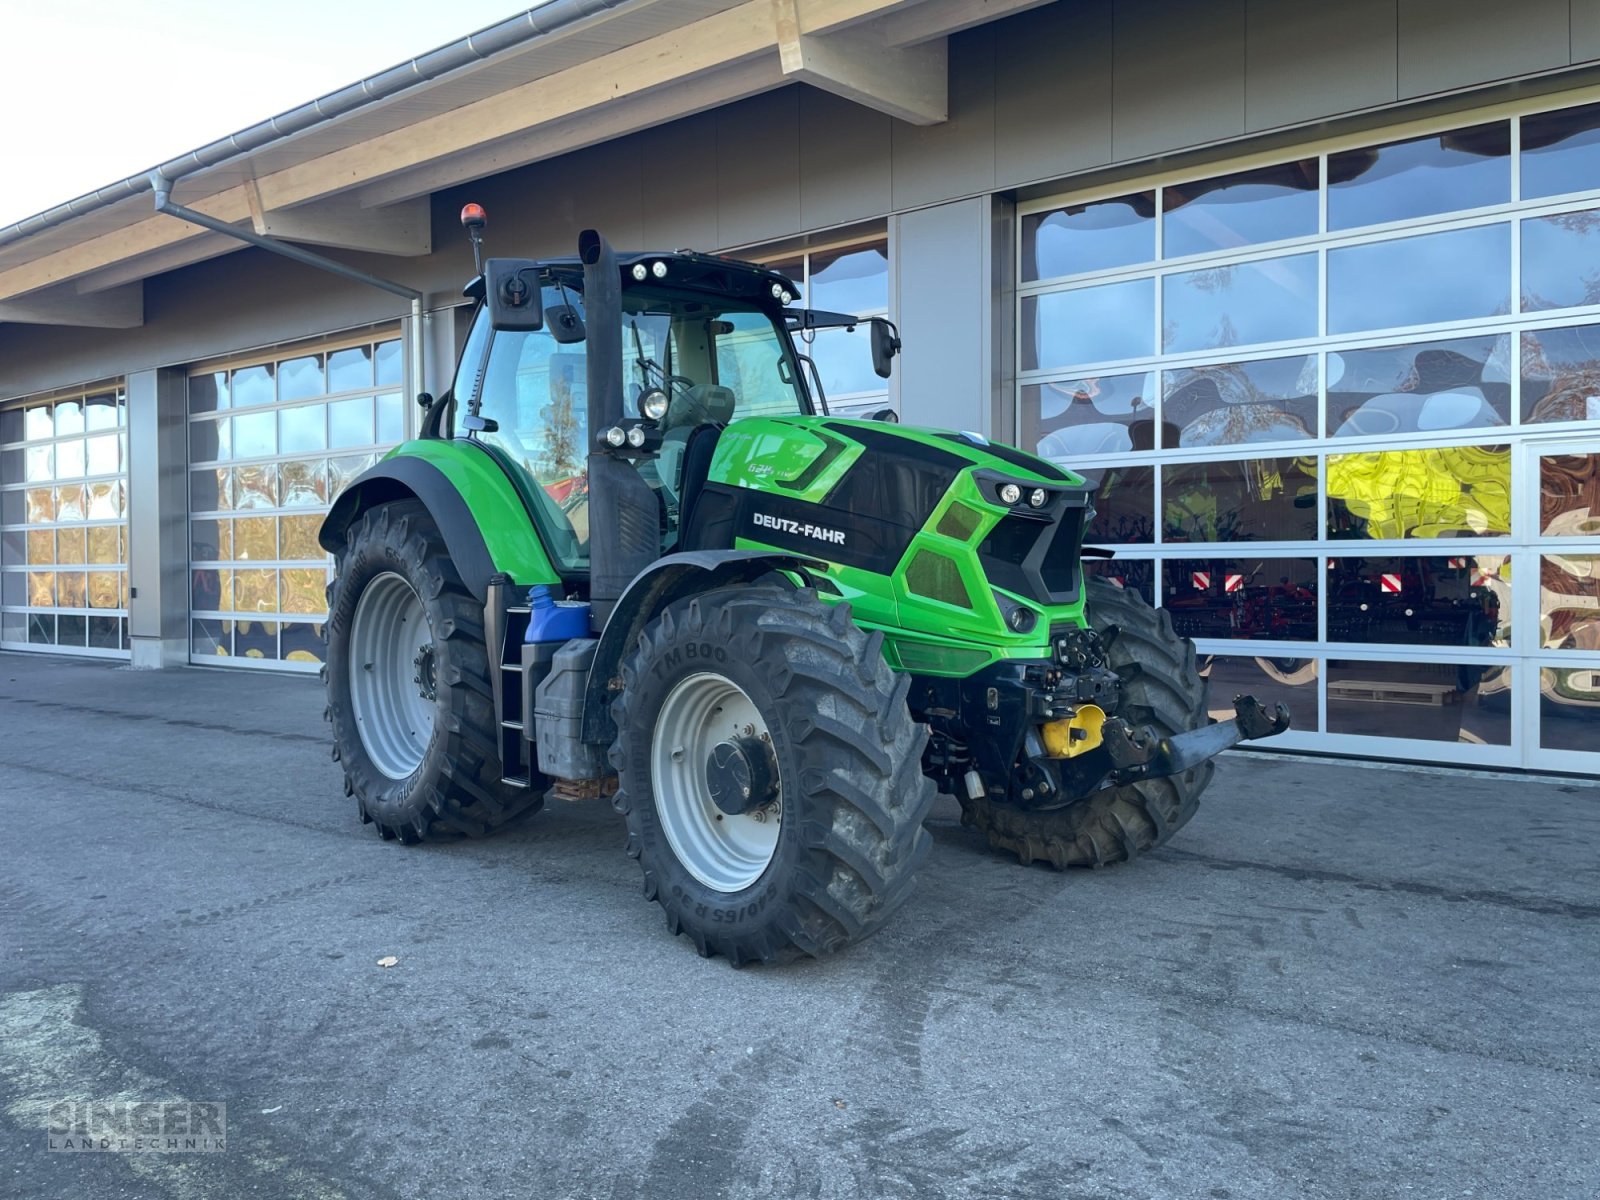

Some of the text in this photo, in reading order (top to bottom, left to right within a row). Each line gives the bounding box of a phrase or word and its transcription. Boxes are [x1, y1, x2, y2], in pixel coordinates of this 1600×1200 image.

[753, 512, 846, 545] DEUTZ-FAHR
[651, 642, 727, 681] TM 800
